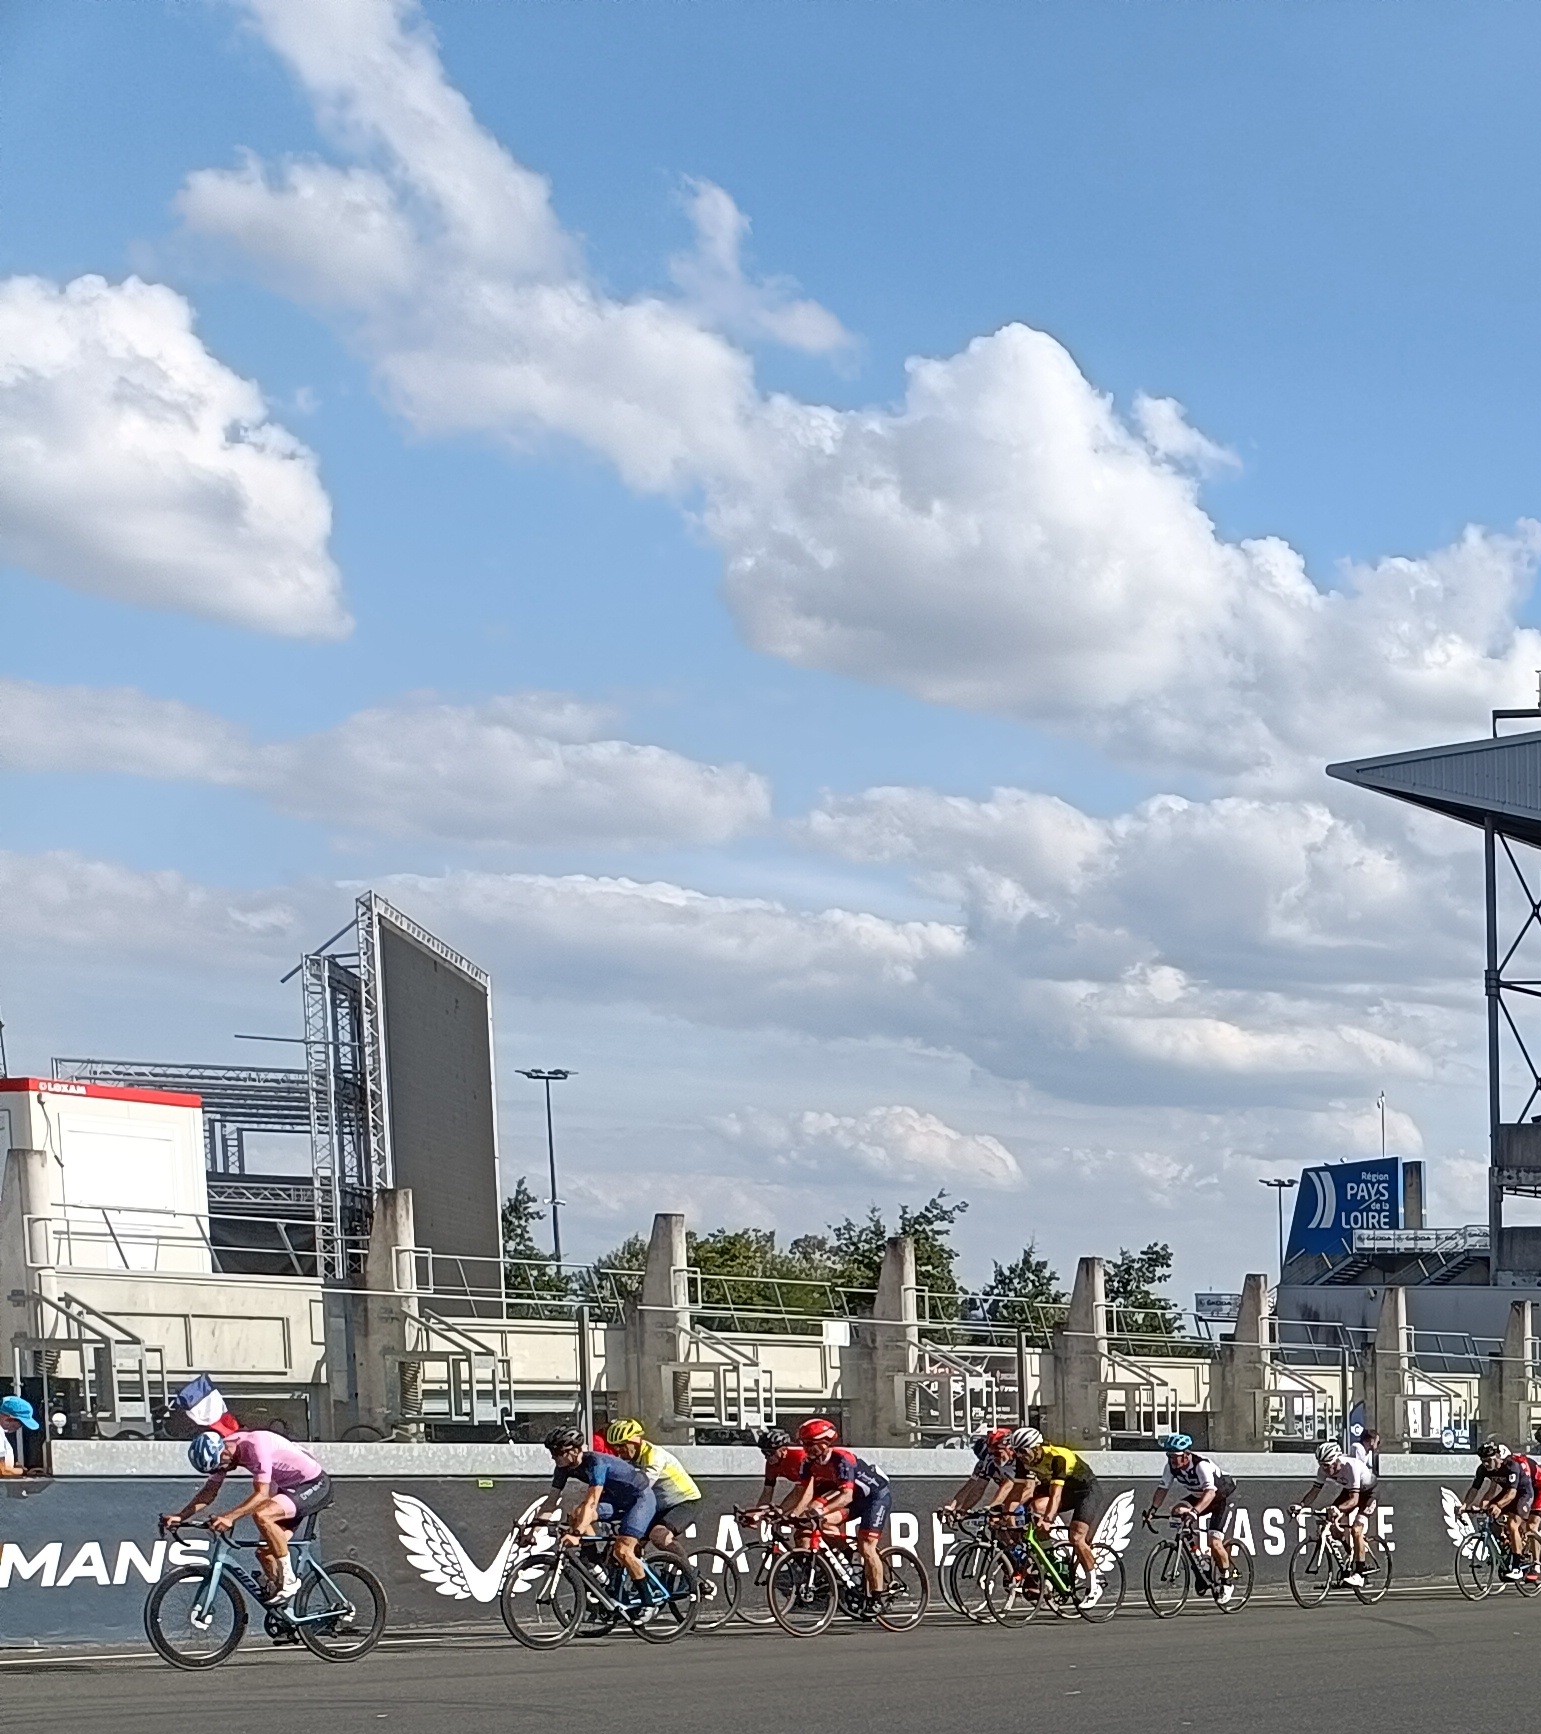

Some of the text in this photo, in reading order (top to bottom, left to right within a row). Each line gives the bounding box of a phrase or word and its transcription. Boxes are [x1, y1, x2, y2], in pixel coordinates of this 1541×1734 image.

[1361, 1172, 1389, 1182] Région
[1346, 1183, 1389, 1200] PAYS
[1370, 1202, 1389, 1210] de la
[1341, 1212, 1390, 1229] LOIRE
[0, 1540, 211, 1589] MANS
